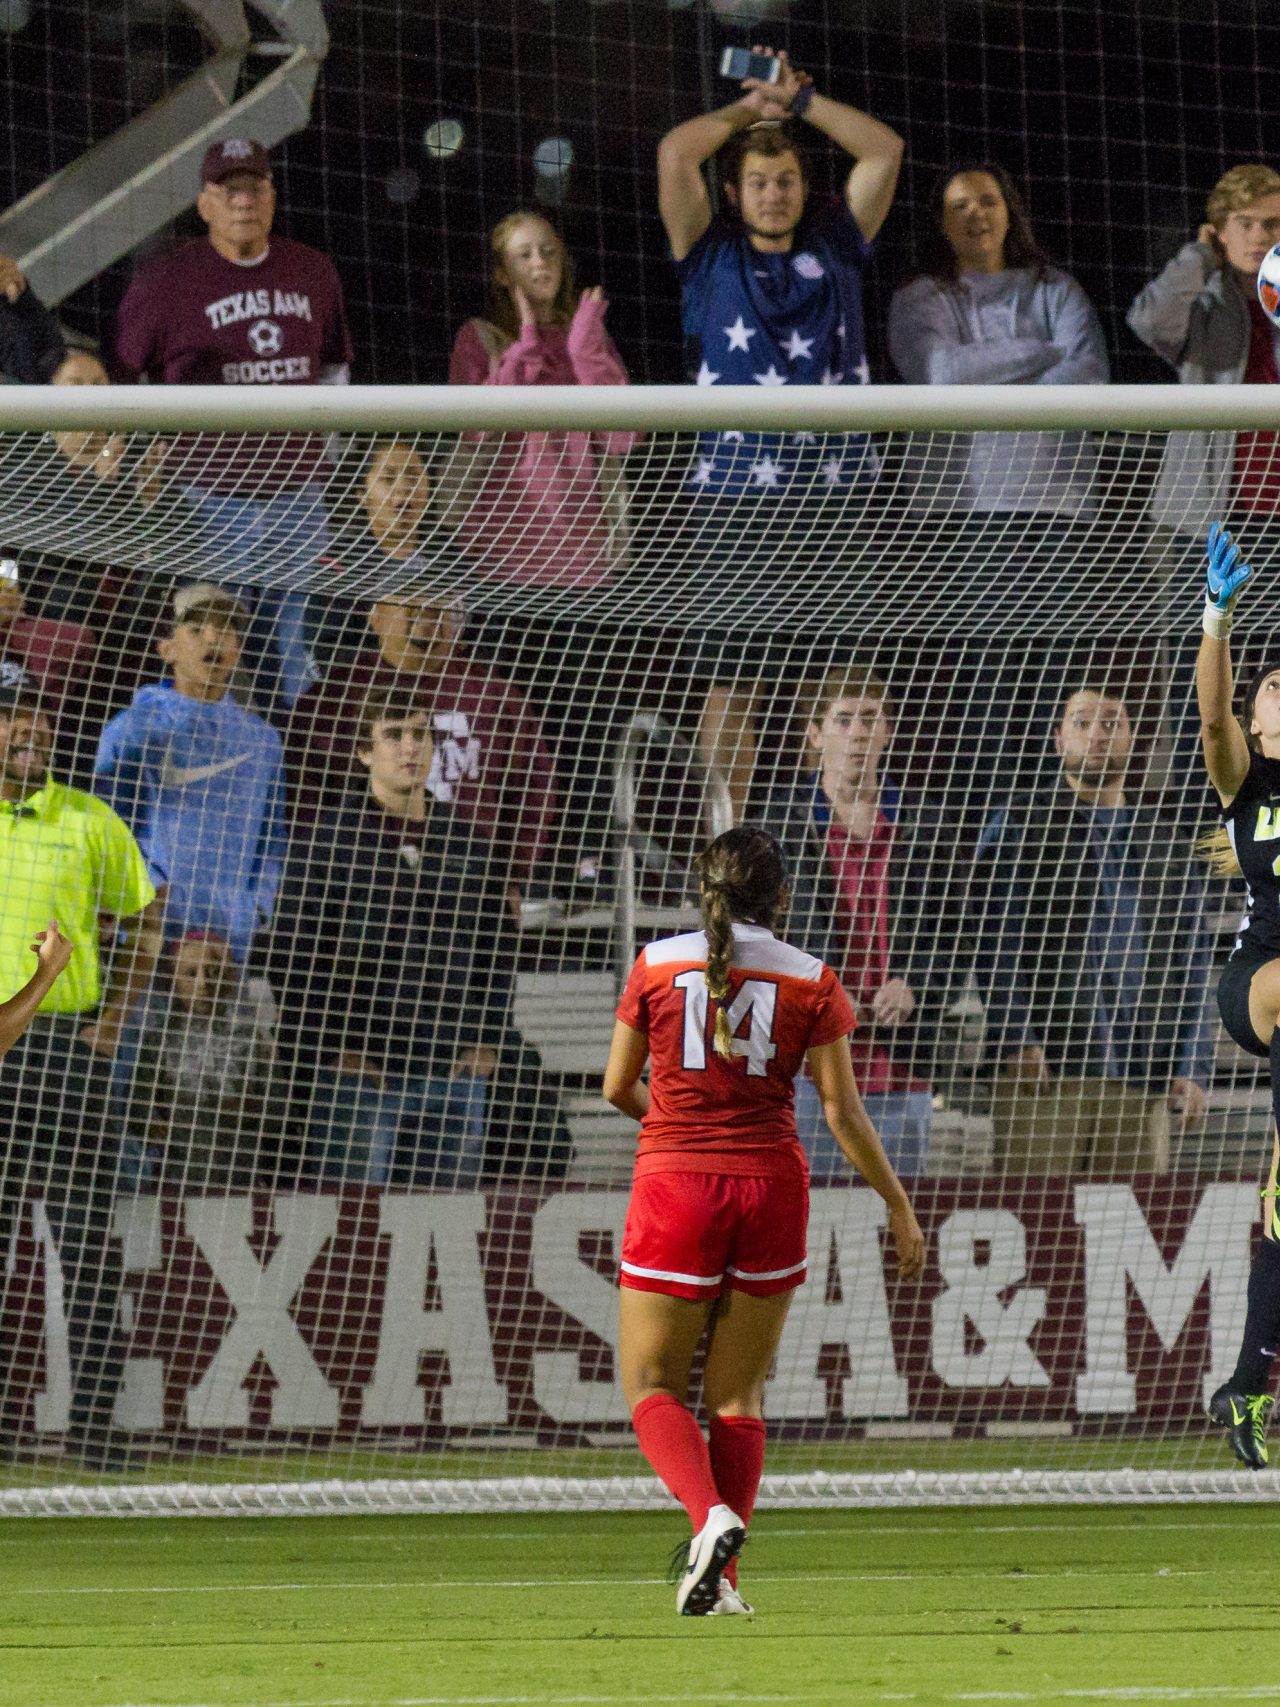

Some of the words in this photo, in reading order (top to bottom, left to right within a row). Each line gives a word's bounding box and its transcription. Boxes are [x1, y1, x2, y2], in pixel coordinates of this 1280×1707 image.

[205, 288, 270, 330] TEXAS
[222, 356, 311, 384] SOCCER
[673, 968, 780, 1077] 14
[758, 1182, 1264, 1420] A&M
